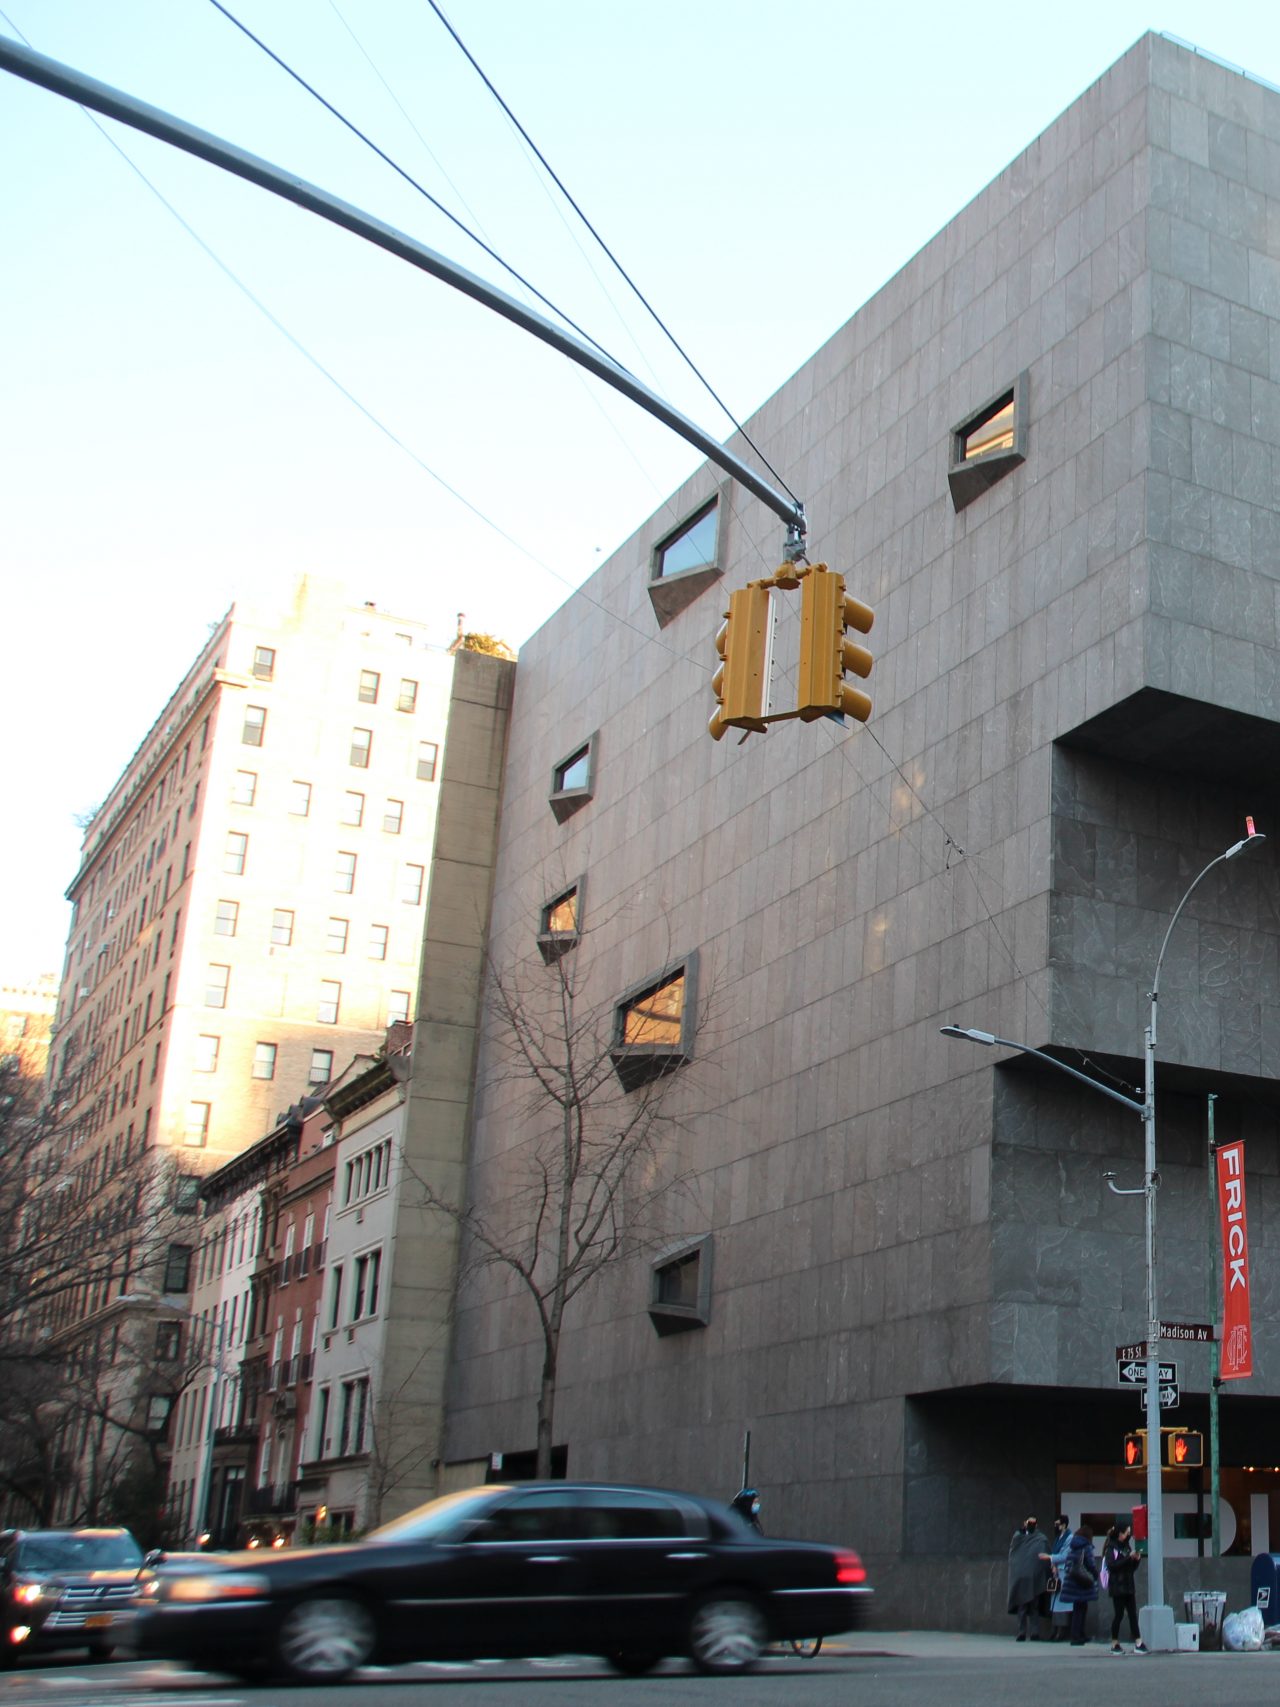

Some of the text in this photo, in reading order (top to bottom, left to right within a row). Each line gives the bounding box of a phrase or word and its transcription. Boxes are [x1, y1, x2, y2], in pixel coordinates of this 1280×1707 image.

[1223, 1148, 1246, 1292] FRICK
[1160, 1326, 1208, 1340] Madison Av
[1122, 1346, 1142, 1360] E 75 St
[1127, 1367, 1145, 1376] ONE
